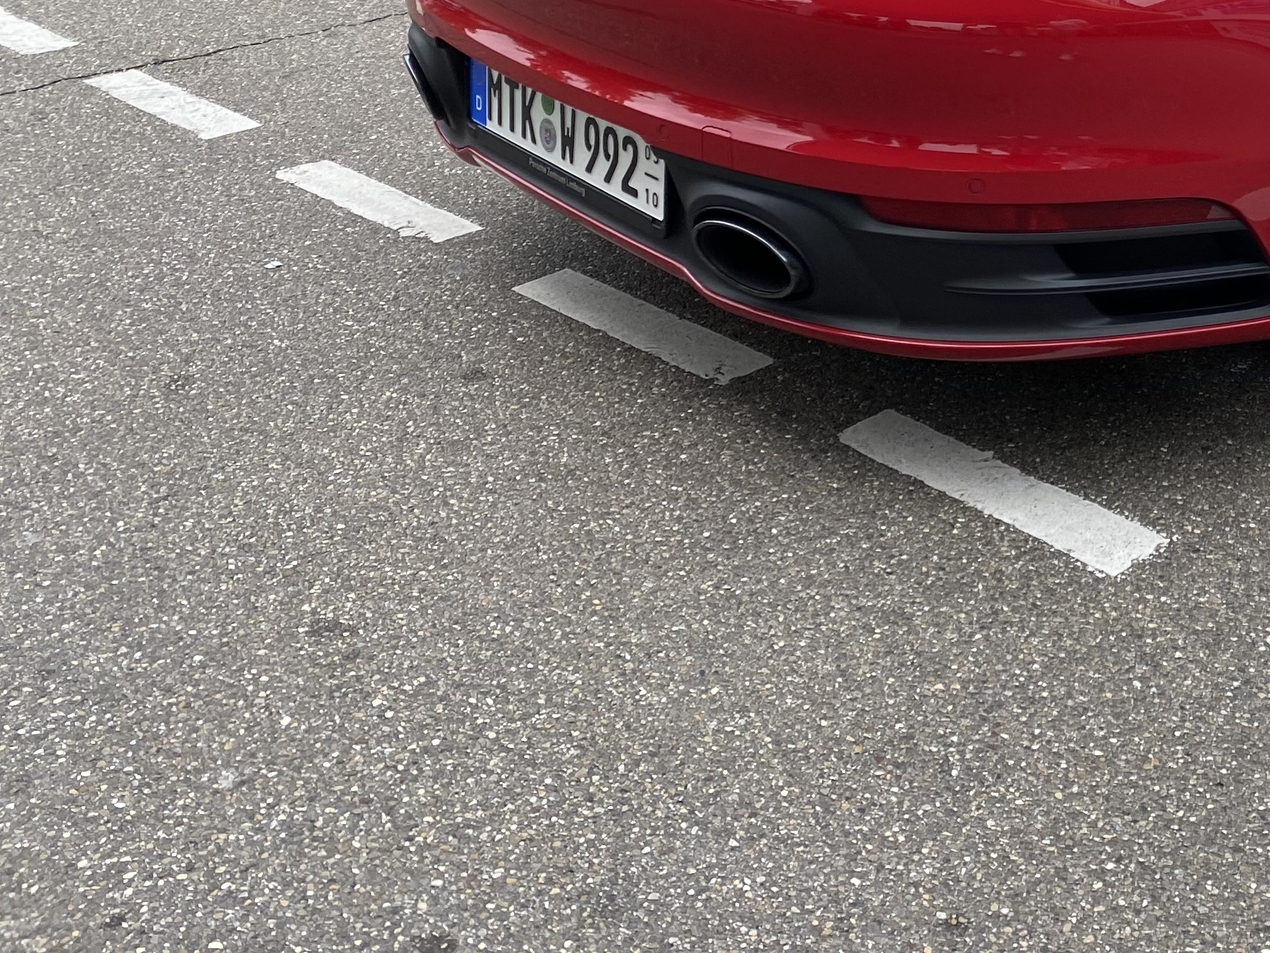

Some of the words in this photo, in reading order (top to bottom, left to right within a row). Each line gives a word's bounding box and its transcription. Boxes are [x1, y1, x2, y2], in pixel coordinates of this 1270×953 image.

[475, 94, 483, 110] D
[487, 68, 537, 145] MTK
[560, 103, 576, 164] W
[584, 115, 639, 199] 992
[645, 188, 659, 208] 10
